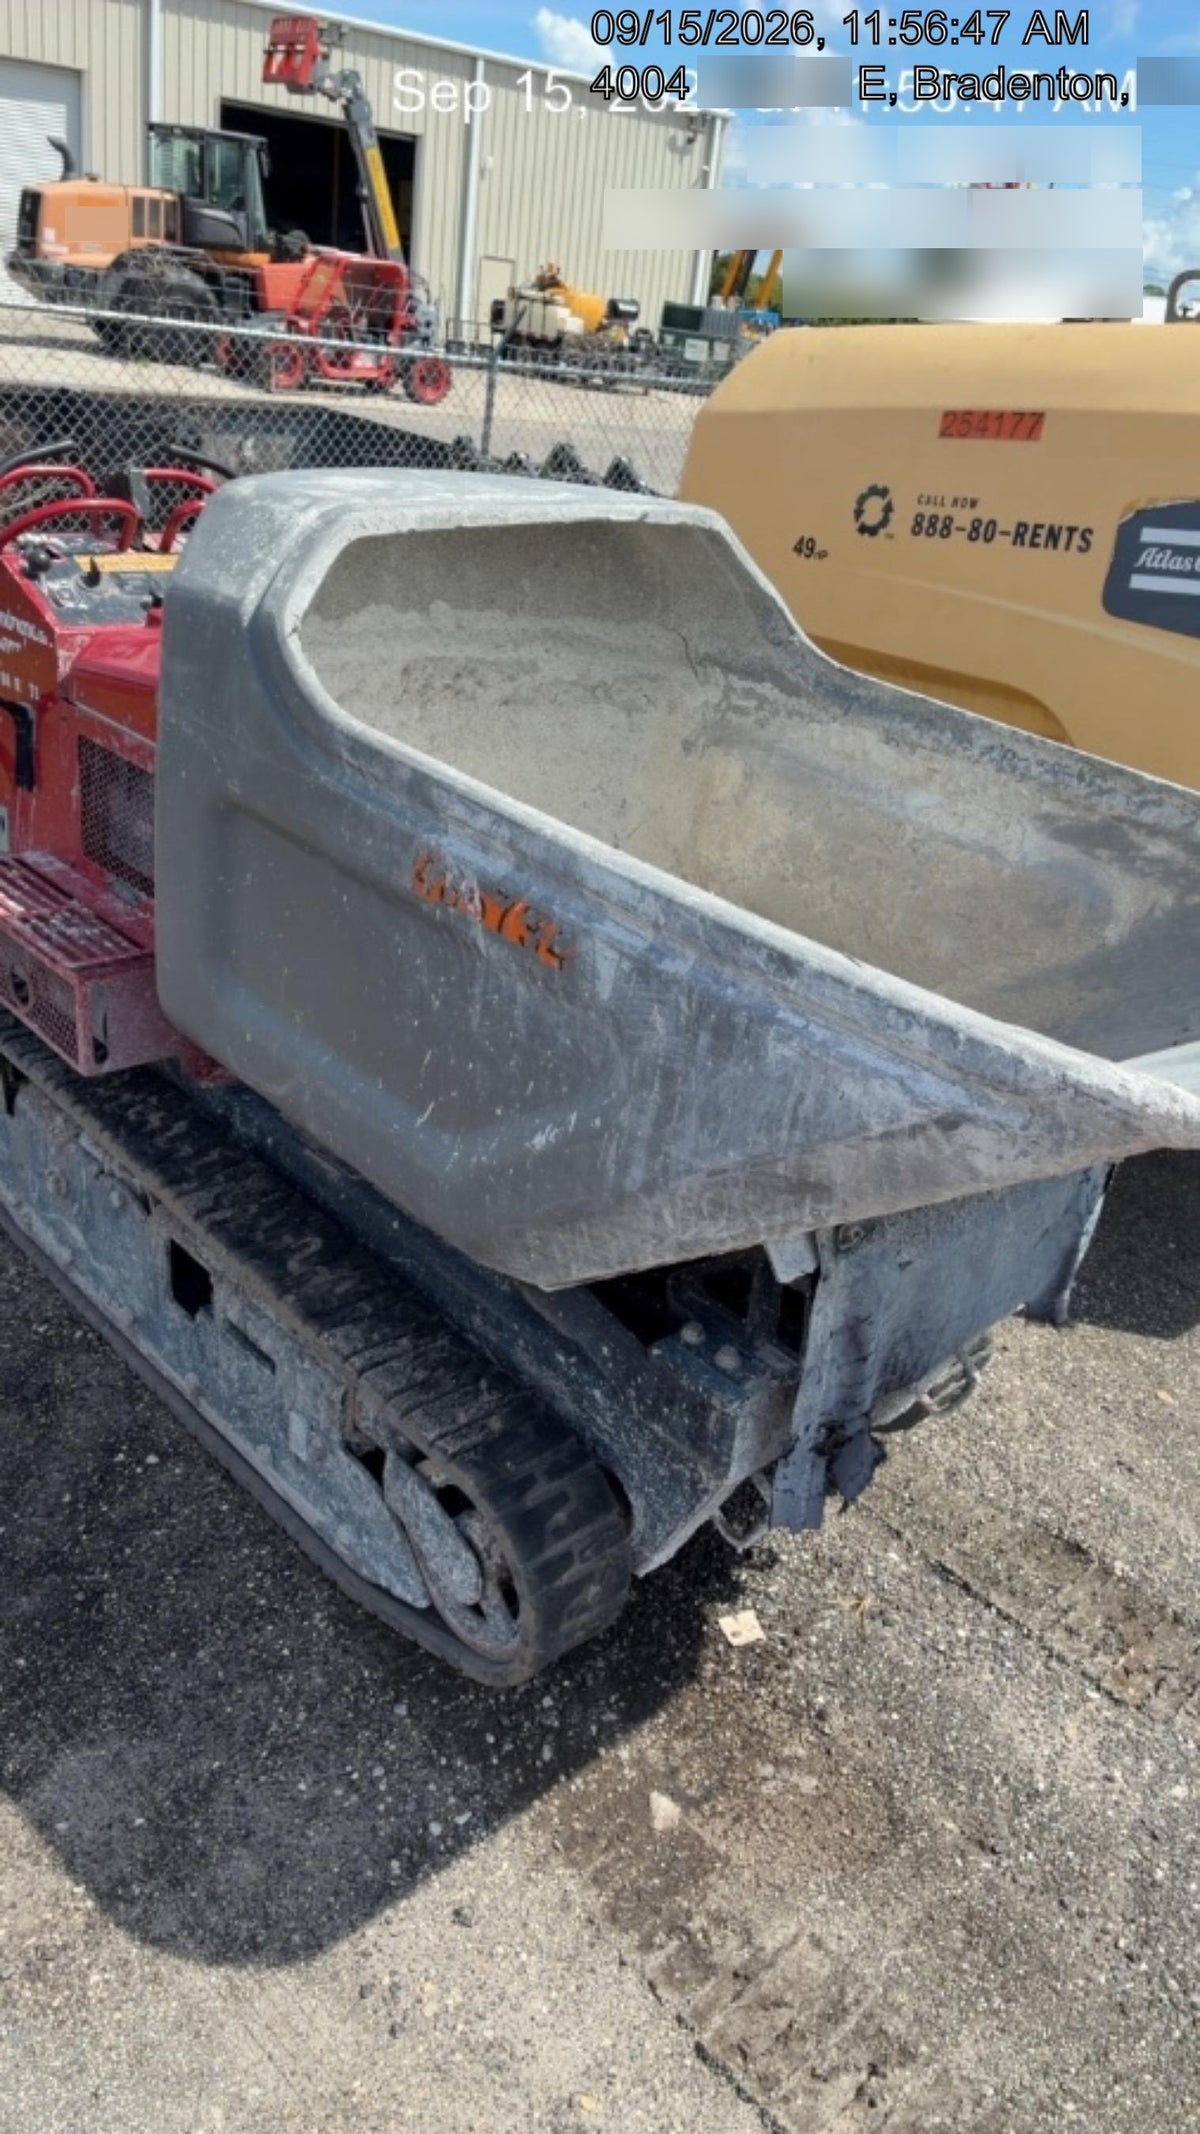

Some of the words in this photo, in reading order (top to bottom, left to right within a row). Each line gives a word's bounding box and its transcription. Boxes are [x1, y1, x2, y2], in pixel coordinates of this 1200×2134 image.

[938, 410, 1045, 440] 254177
[916, 493, 947, 508] CALL
[951, 497, 980, 510] NOW
[911, 511, 1094, 553] 888-80-RENTS
[1133, 547, 1194, 572] Atlas
